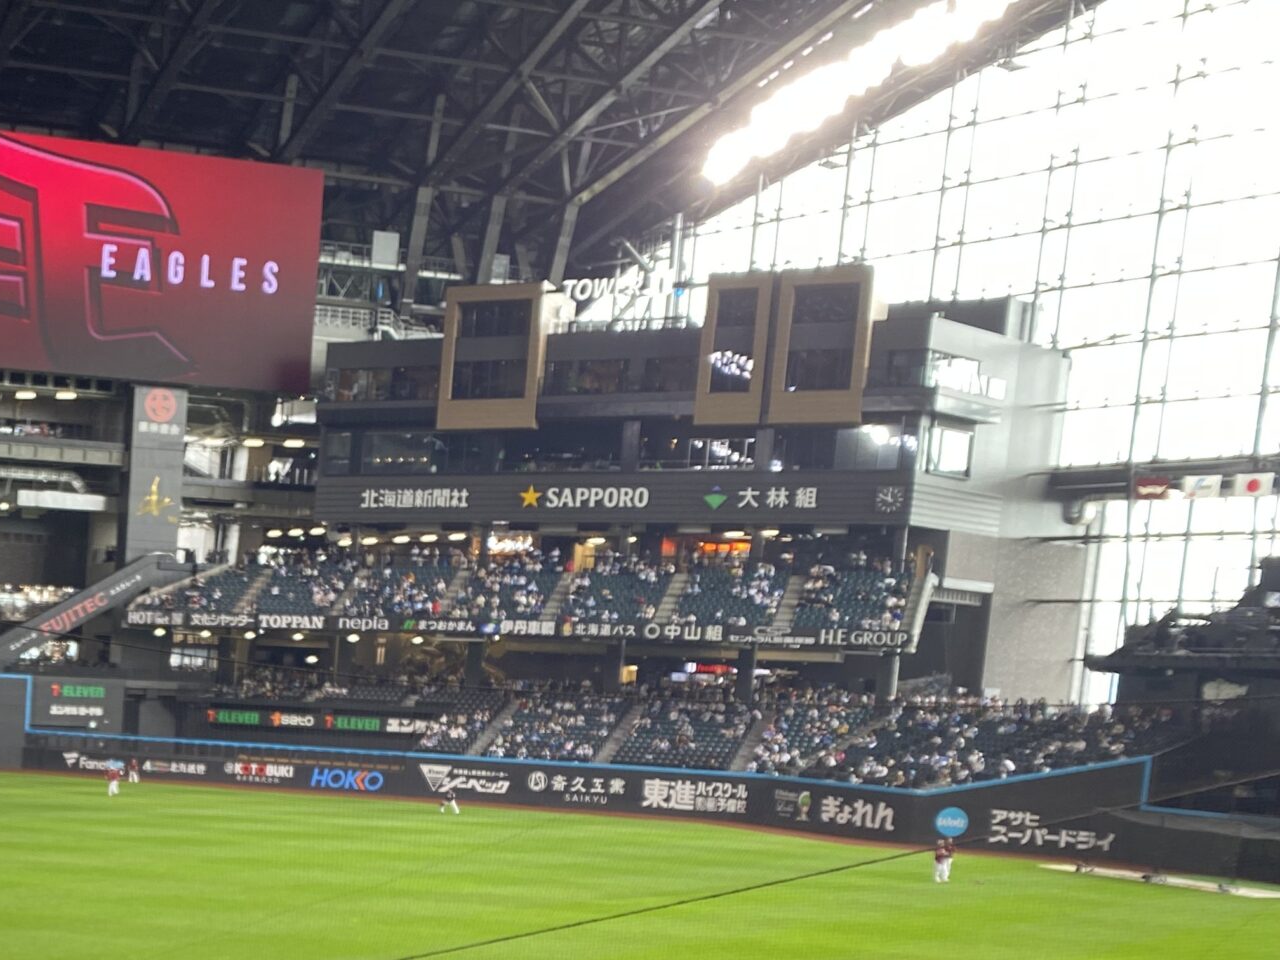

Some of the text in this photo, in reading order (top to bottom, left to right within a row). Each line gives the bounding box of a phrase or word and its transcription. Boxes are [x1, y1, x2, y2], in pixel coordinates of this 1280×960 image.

[101, 244, 279, 294] EAGLES
[360, 488, 469, 508] 北海道新聞社
[546, 487, 650, 508] SAPPORO
[737, 487, 817, 508] 大林組
[40, 592, 108, 636] FUJITEC
[259, 614, 325, 629] TOPPAN
[338, 616, 389, 632] nepia
[575, 623, 636, 637] 北海道バス
[664, 624, 723, 641] 中山組
[851, 631, 907, 646] GROUP
[234, 762, 295, 777] KOTOBUKI
[565, 793, 608, 805] SAIKYU
[642, 778, 695, 810] 東進
[821, 796, 895, 831] ぎょれん
[990, 809, 1040, 826] アサヒ
[988, 825, 1115, 851] スーパードライ
